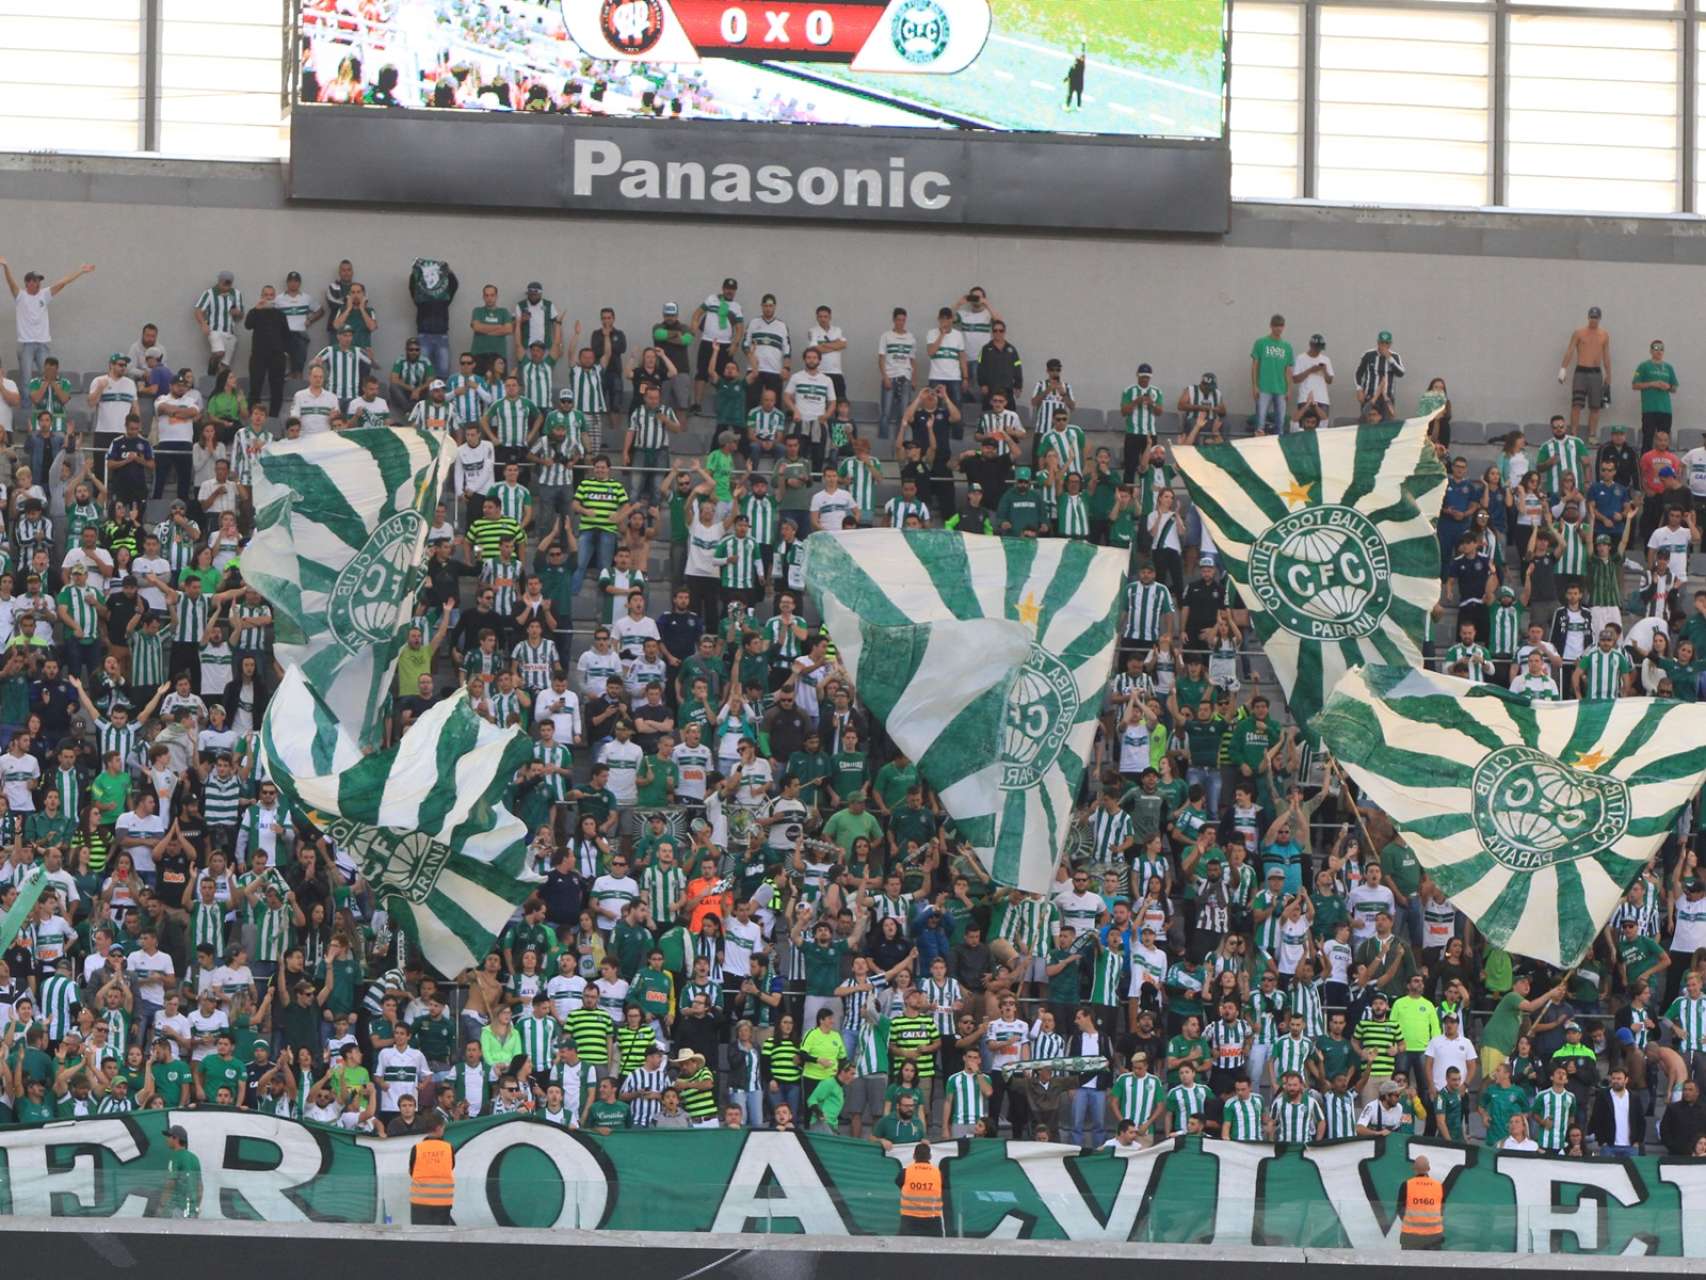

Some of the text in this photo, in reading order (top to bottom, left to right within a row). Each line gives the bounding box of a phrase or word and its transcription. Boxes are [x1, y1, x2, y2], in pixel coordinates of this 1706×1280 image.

[720, 8, 748, 44] 0
[805, 10, 834, 45] 0
[573, 138, 952, 210] Panasonic
[1252, 510, 1388, 611] CORITIB FOOT BALL CLUB
[1287, 552, 1367, 597] CFC
[902, 1030, 927, 1038] CAIXA
[910, 1182, 934, 1191] 0017
[1412, 1197, 1435, 1206] 0160
